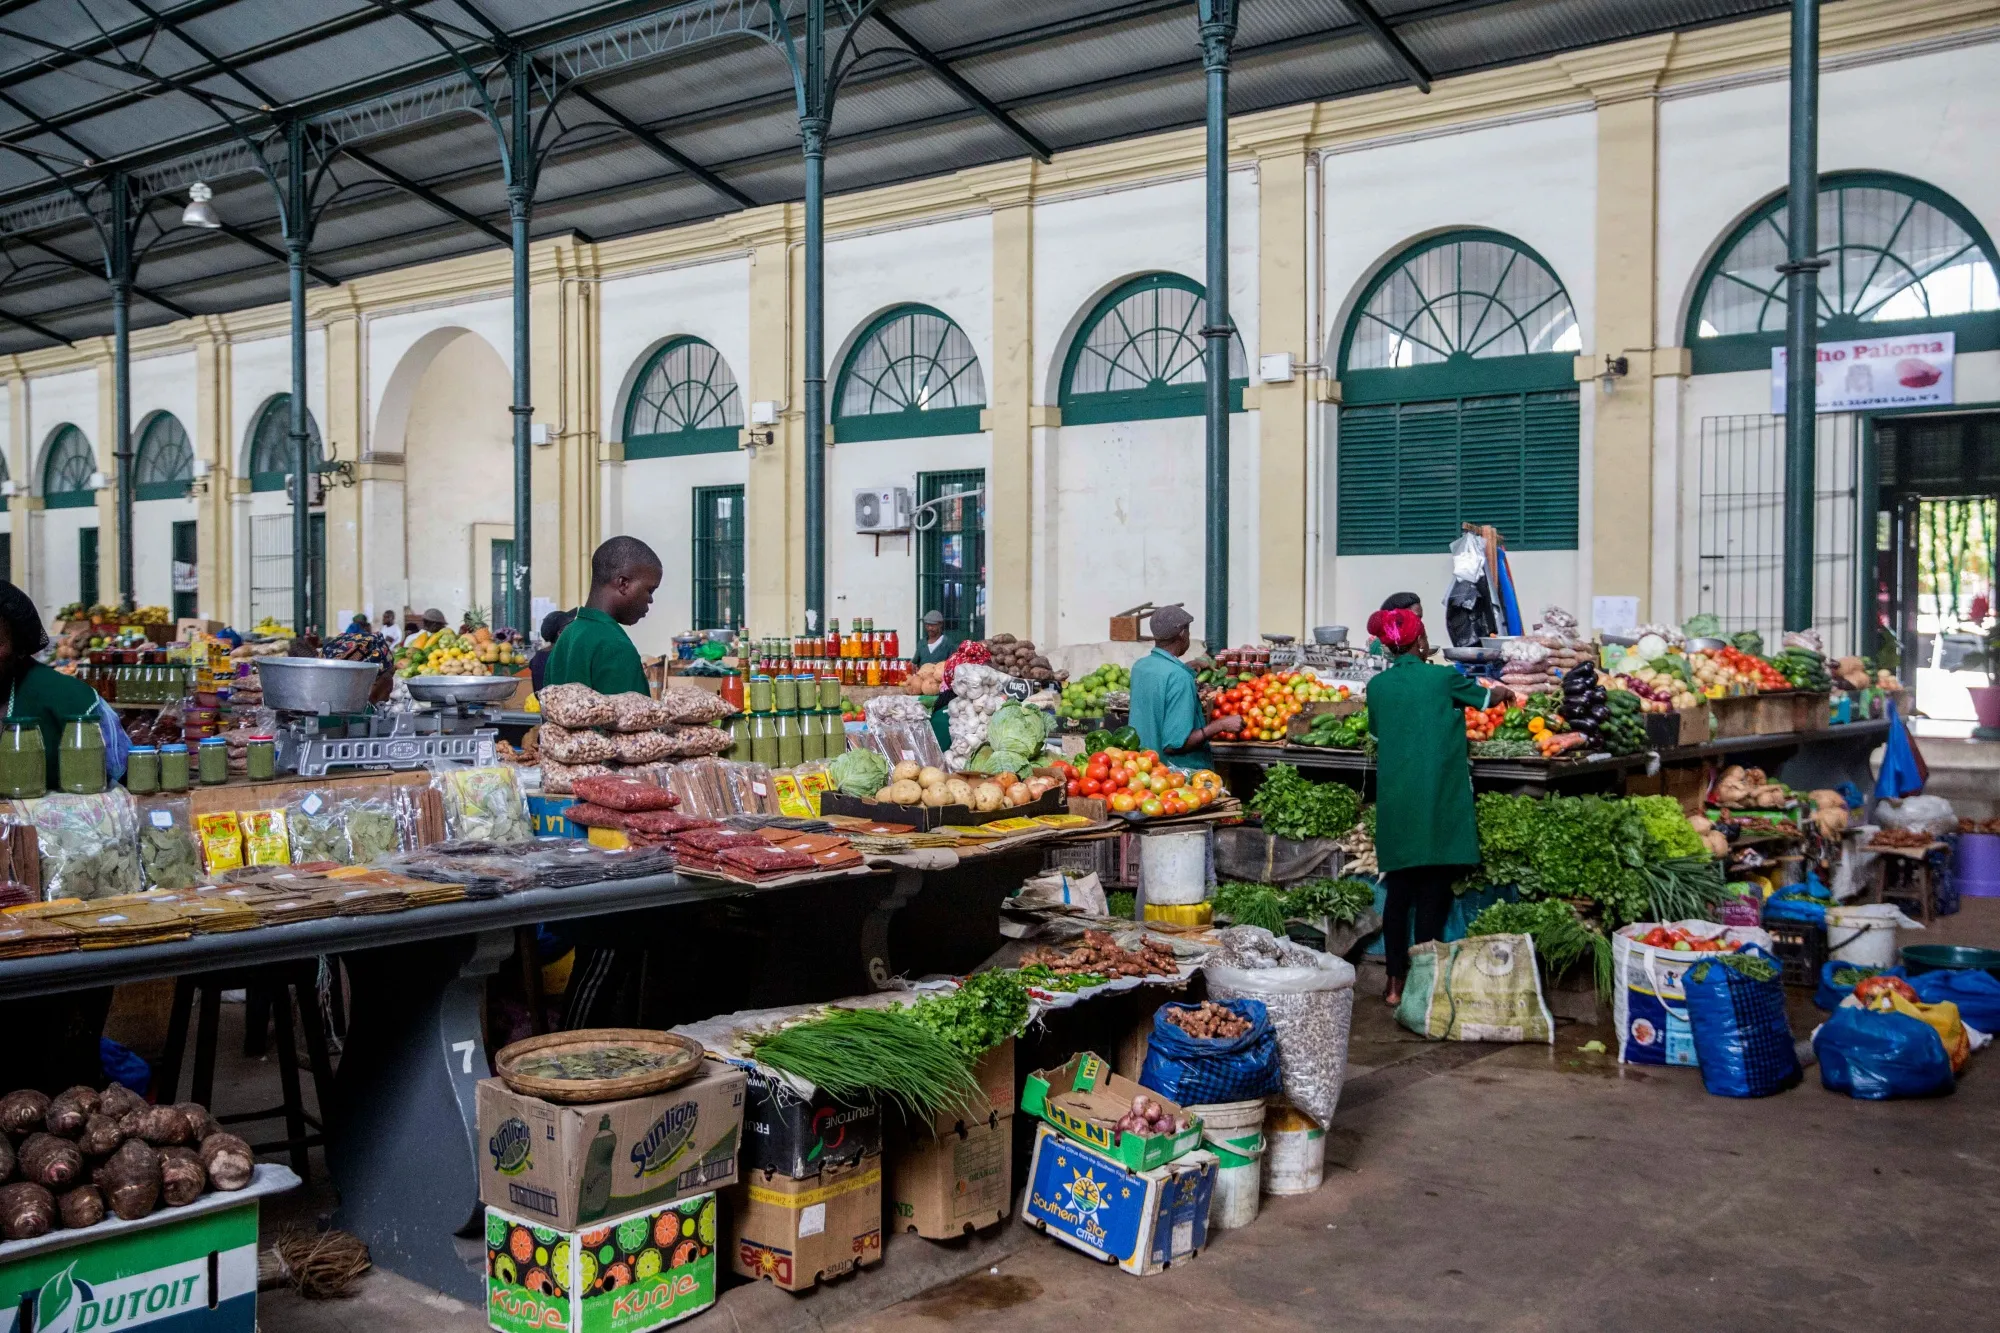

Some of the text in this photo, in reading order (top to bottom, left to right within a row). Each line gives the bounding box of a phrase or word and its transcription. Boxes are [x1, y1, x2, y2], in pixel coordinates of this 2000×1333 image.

[1852, 340, 1943, 361] Paloma
[545, 814, 564, 833] LA
[451, 1039, 476, 1075] 7
[825, 1104, 876, 1129] FRUITONE
[489, 1117, 531, 1171] Sunlight
[630, 1100, 699, 1179] Sunlight
[1032, 1191, 1108, 1240] Southern Star
[852, 1232, 880, 1255] Dole
[1075, 1227, 1105, 1249] CITRUS
[740, 1245, 793, 1286] Dole
[826, 1258, 854, 1275] Citrus
[75, 1273, 201, 1333] DUTOIT
[490, 1287, 568, 1330] Kunje
[611, 1274, 699, 1311] Kunje
